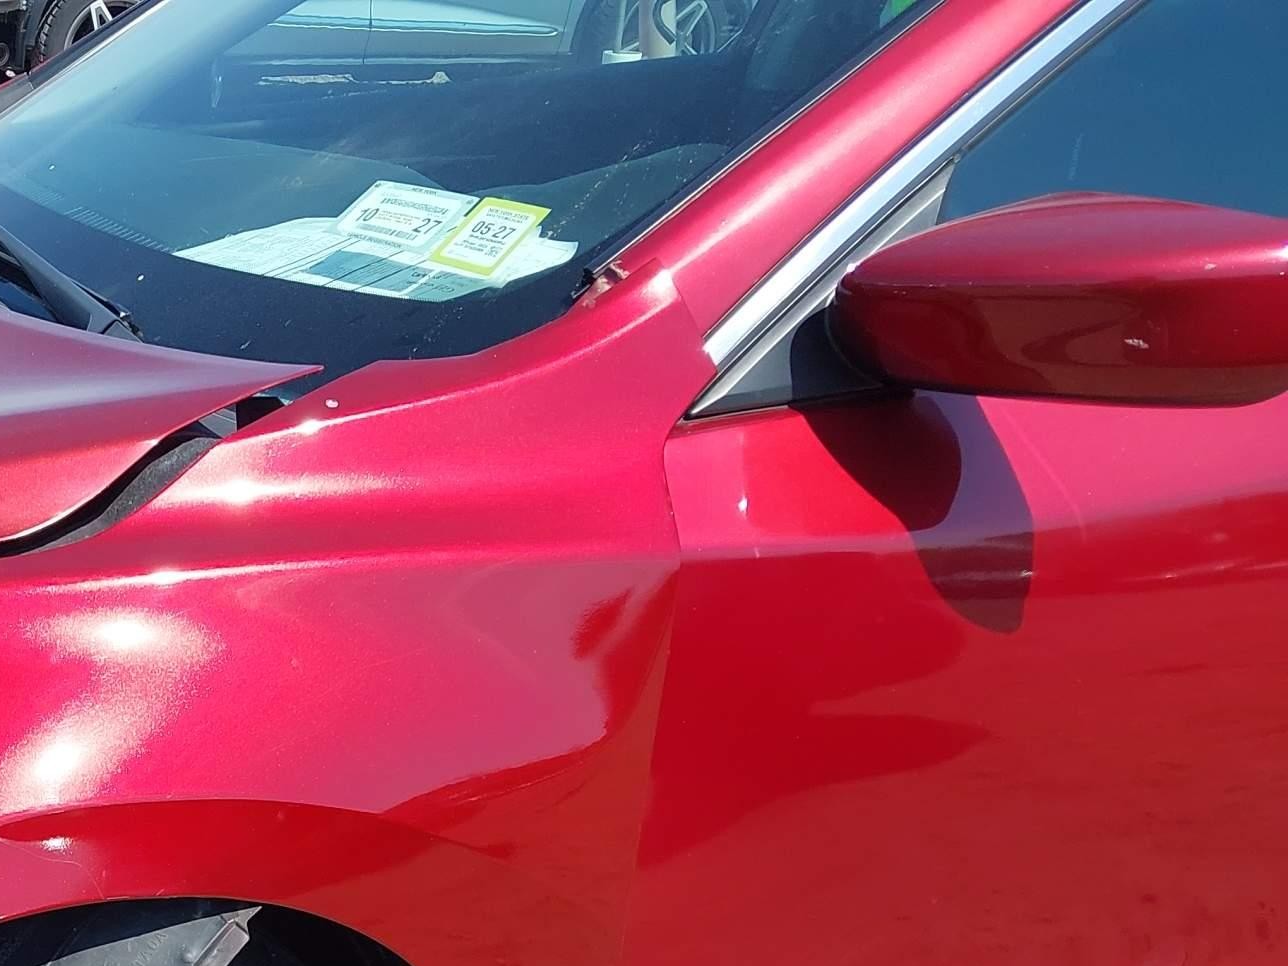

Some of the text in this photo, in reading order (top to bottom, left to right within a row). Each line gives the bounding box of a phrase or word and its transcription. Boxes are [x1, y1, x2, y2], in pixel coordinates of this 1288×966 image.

[355, 207, 380, 222] 10
[412, 217, 443, 235] 27
[471, 220, 517, 240] 05 27
